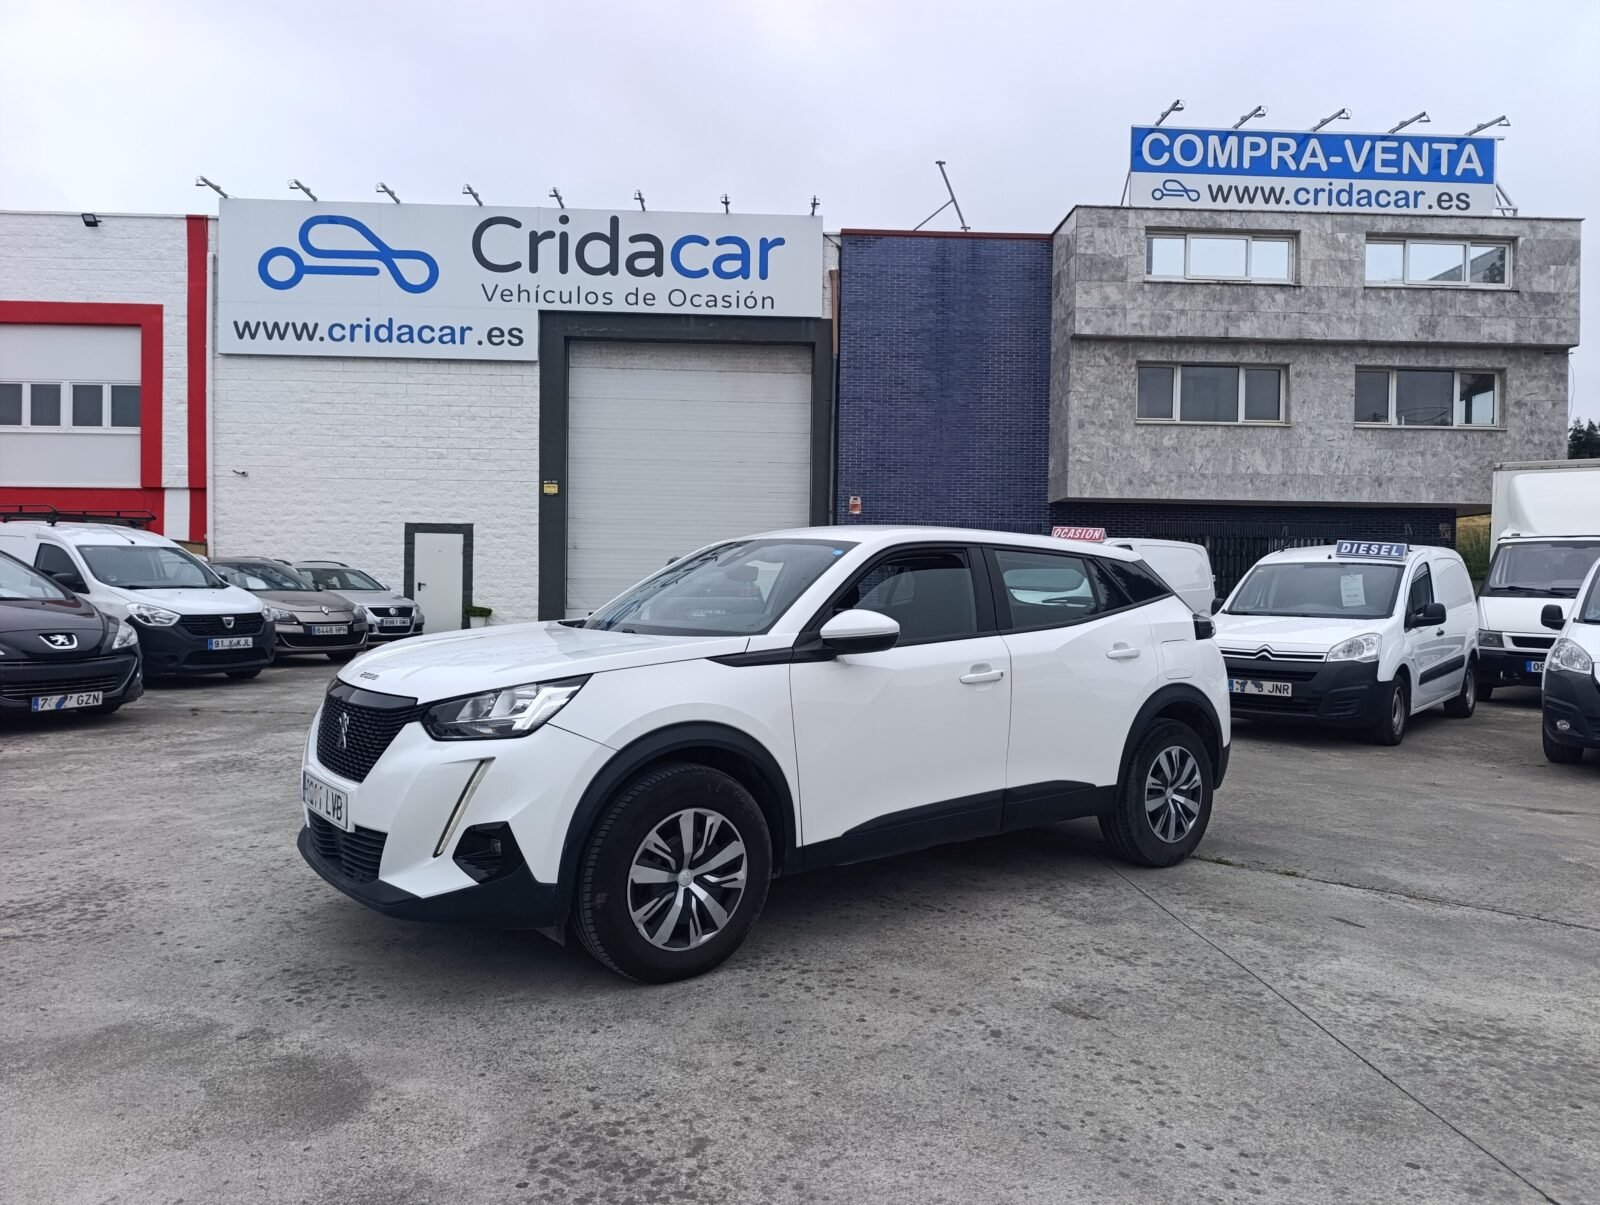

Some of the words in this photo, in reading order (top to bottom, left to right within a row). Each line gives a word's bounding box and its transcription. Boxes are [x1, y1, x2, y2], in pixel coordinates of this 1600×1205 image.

[1141, 132, 1484, 177] COMPRA-VENTA
[1207, 182, 1471, 211] www.cridacar.es
[472, 214, 786, 281] Cridacar
[481, 283, 614, 306] Vehículos
[624, 287, 656, 307] de
[667, 288, 775, 310] Ocasión
[233, 317, 525, 347] www.cridacar.es
[1053, 528, 1102, 540] OCASION
[1341, 543, 1400, 556] DIESEL
[76, 693, 100, 705] GZN
[1267, 683, 1290, 695] JNR
[325, 789, 343, 821] LVB
